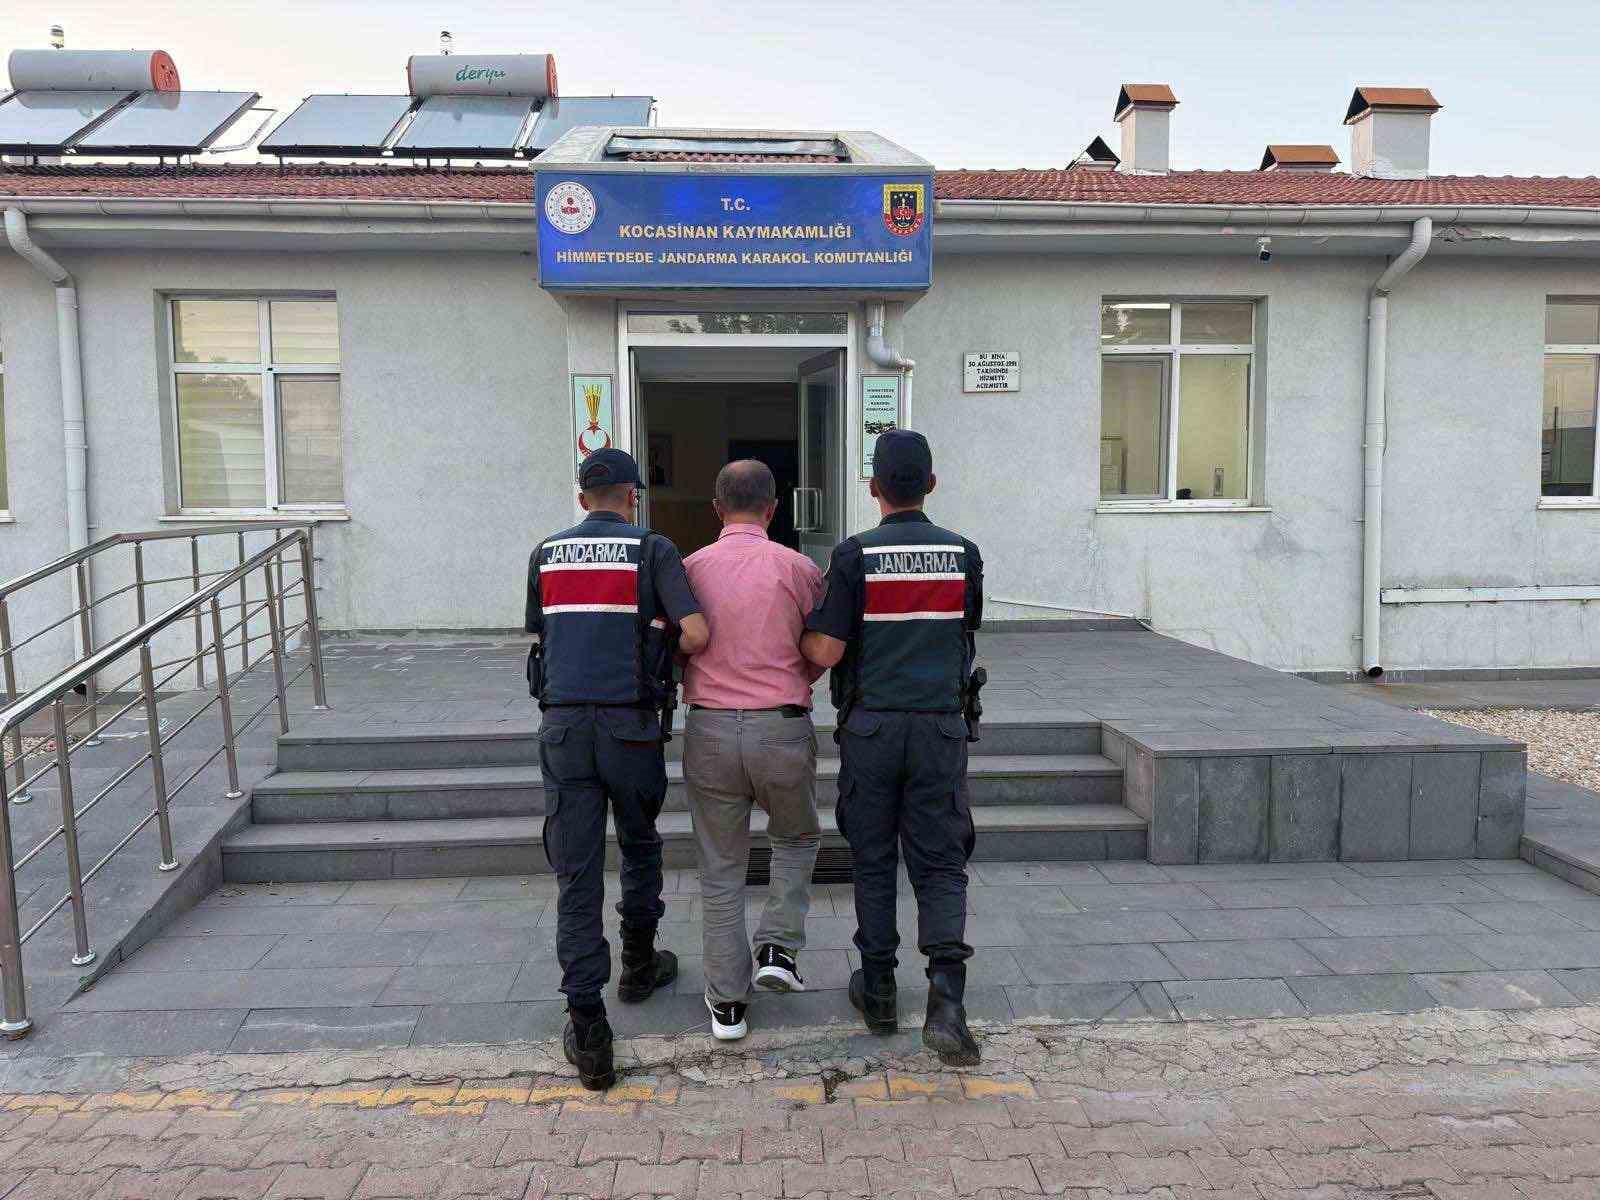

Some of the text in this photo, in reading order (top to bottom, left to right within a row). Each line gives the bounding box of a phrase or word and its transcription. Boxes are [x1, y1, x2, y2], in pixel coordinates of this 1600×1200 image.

[720, 197, 750, 211] T.C.
[618, 223, 852, 240] KOCASİNAN KAYMAKAMLIĞI
[556, 249, 913, 265] HİMMETDEDE JANDARMA KARAKOL KOMUTANLIĞI
[547, 543, 628, 563] JANDARMA
[875, 552, 959, 573] JANDARMA
